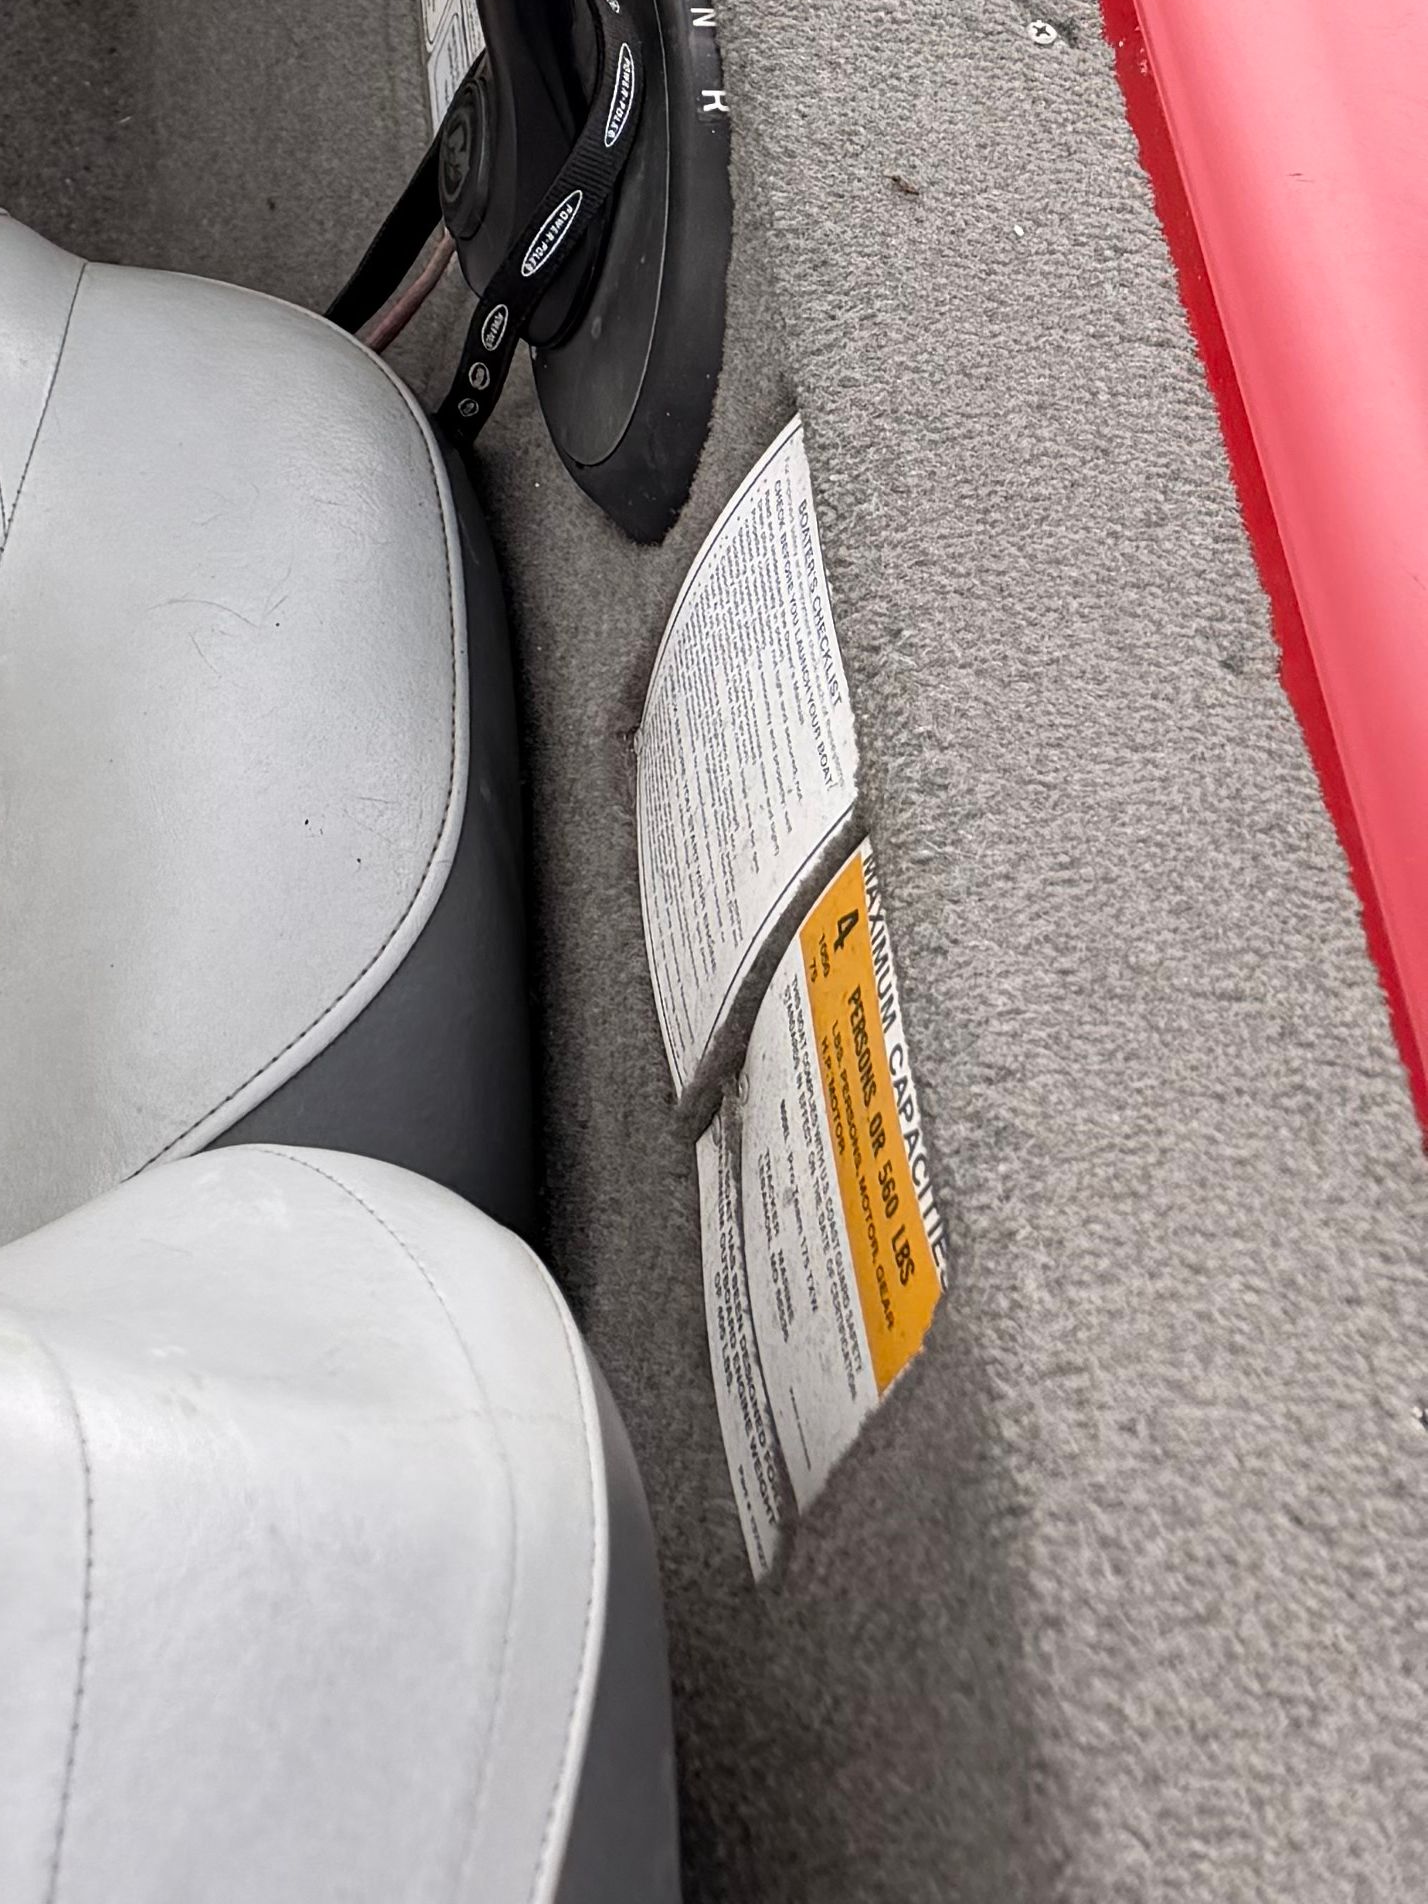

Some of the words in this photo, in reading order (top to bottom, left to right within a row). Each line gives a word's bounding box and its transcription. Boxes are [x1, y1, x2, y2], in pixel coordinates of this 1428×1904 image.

[690, 8, 717, 26] N
[773, 478, 786, 531] CHECK
[779, 531, 794, 595] BEFORE
[788, 593, 799, 627] YOU
[797, 497, 818, 595] BOATER'S
[811, 593, 841, 709] CHECKLIST
[794, 627, 812, 694] LAUNCH
[806, 690, 822, 741] YOUR
[834, 905, 857, 955] 4
[861, 852, 898, 1034] MAXIMUM
[807, 957, 818, 984] 75
[846, 984, 878, 1109] PERSONS
[797, 1090, 812, 1149] EFFECT
[867, 1111, 887, 1158] OR
[807, 1149, 817, 1177] ON
[876, 1158, 900, 1220] 560
[811, 1177, 823, 1211] THE
[726, 1226, 737, 1270] HAS
[825, 1256, 835, 1281] OF
[890, 1223, 916, 1289] LBS
[712, 1271, 722, 1298] OF
[730, 1273, 745, 1331] BEEN
[824, 1195, 840, 1251] COAST
[834, 1249, 851, 1310] GUARD
[845, 1307, 863, 1375] SAFETY
[875, 1263, 896, 1332] GEAR
[718, 1231, 737, 1349] OUTBOARD
[731, 1352, 754, 1437] ENGINE
[746, 1436, 776, 1525] WEIGHT
[738, 1333, 768, 1447] DESIGNED
